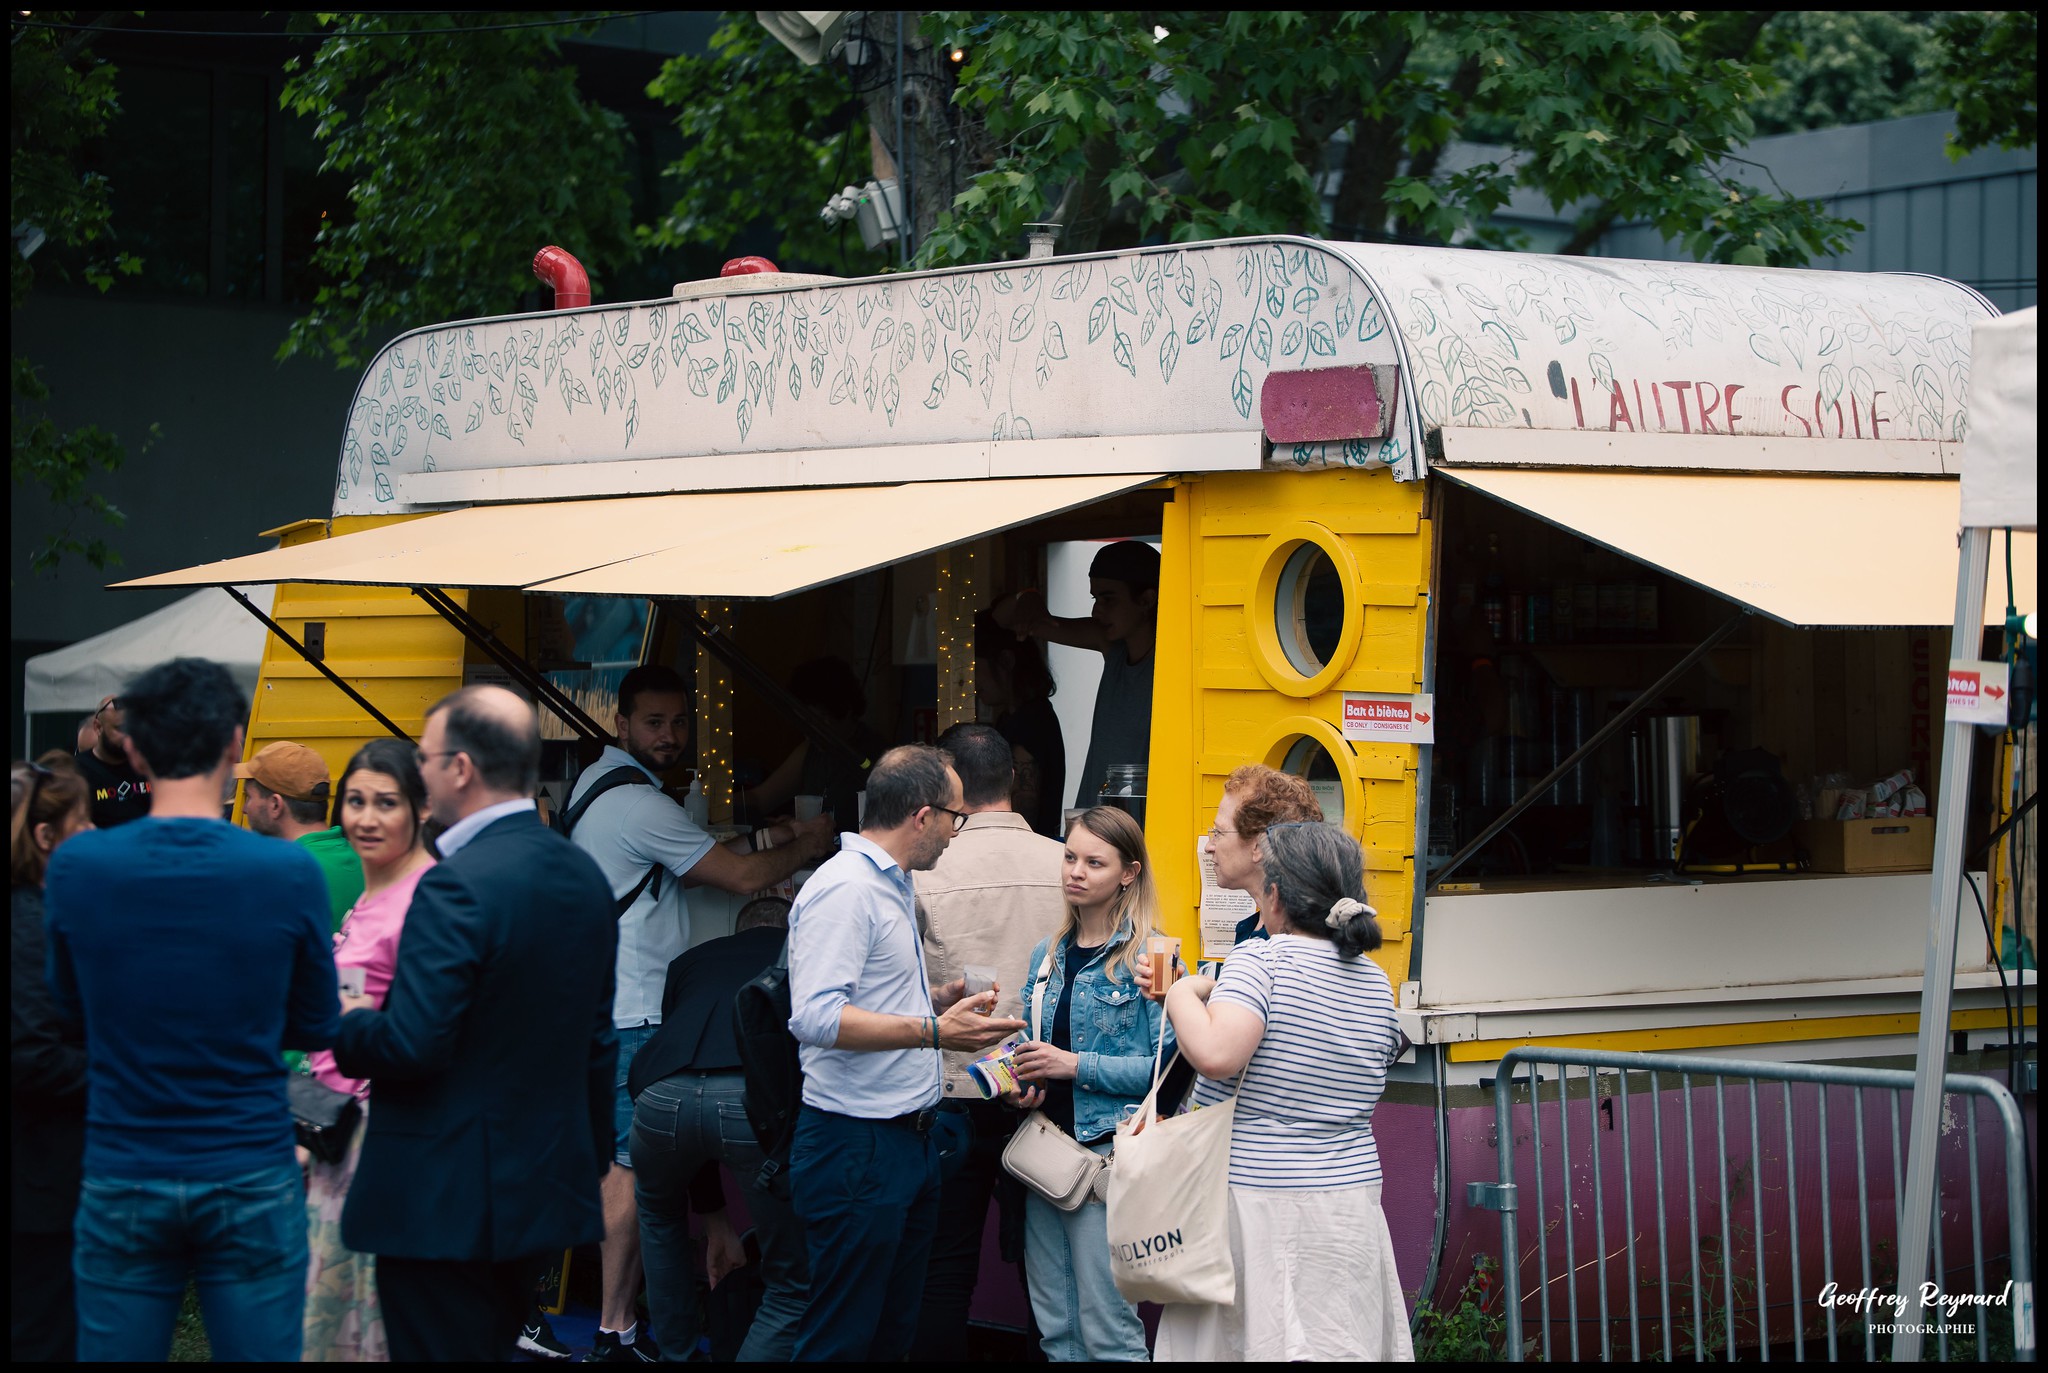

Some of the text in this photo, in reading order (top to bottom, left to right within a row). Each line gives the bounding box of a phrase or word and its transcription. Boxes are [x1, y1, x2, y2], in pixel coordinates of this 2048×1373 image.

[1570, 376, 1892, 440] L'AUTRE SOIE
[1346, 704, 1410, 719] Bar à bières
[1355, 721, 1368, 729] ONLY
[1373, 722, 1403, 730] CONSIGNES
